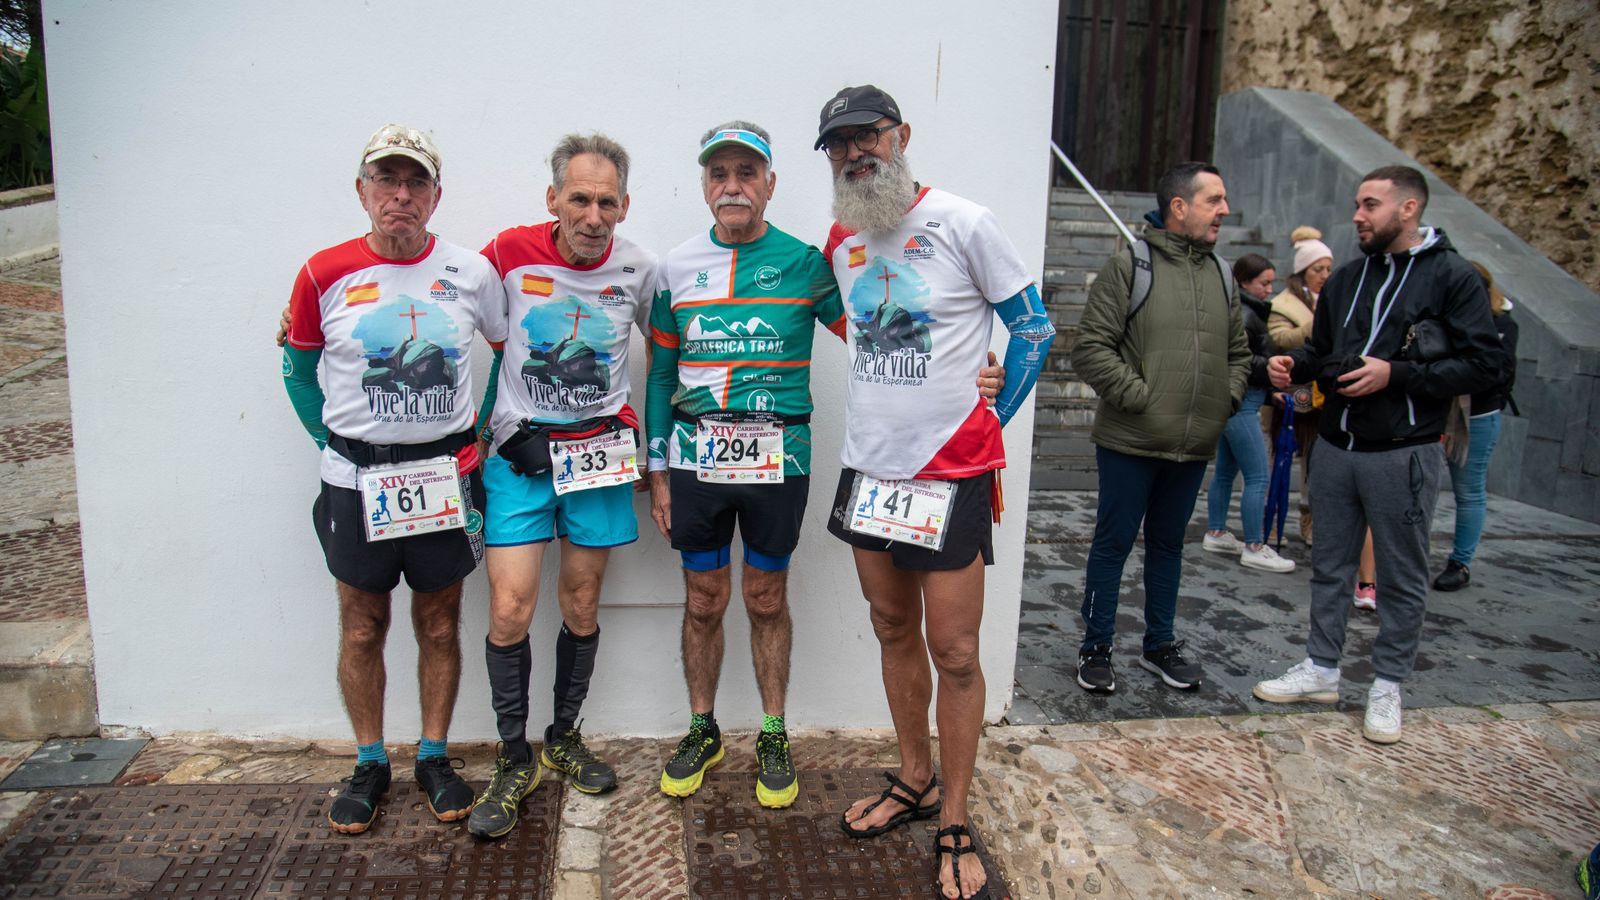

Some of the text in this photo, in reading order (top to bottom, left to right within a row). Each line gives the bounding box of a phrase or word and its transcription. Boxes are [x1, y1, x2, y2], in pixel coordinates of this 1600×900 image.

[749, 340, 784, 354] TRAIL
[872, 347, 887, 376] la
[890, 347, 928, 379] vida
[365, 385, 455, 415] Vive la vida
[523, 375, 555, 404] Vive
[556, 380, 570, 406] la
[393, 414, 403, 423] de
[405, 413, 413, 423] la
[709, 425, 735, 439] XIV
[564, 440, 591, 455] XIV
[715, 437, 760, 462] 294
[580, 449, 608, 473] 33
[378, 474, 407, 490] XIV
[408, 470, 438, 480] CARRERA
[422, 474, 454, 485] ESTRECHO
[397, 484, 427, 514] 61
[901, 485, 947, 501] DEL ESTRECHO
[882, 489, 914, 520] 41
